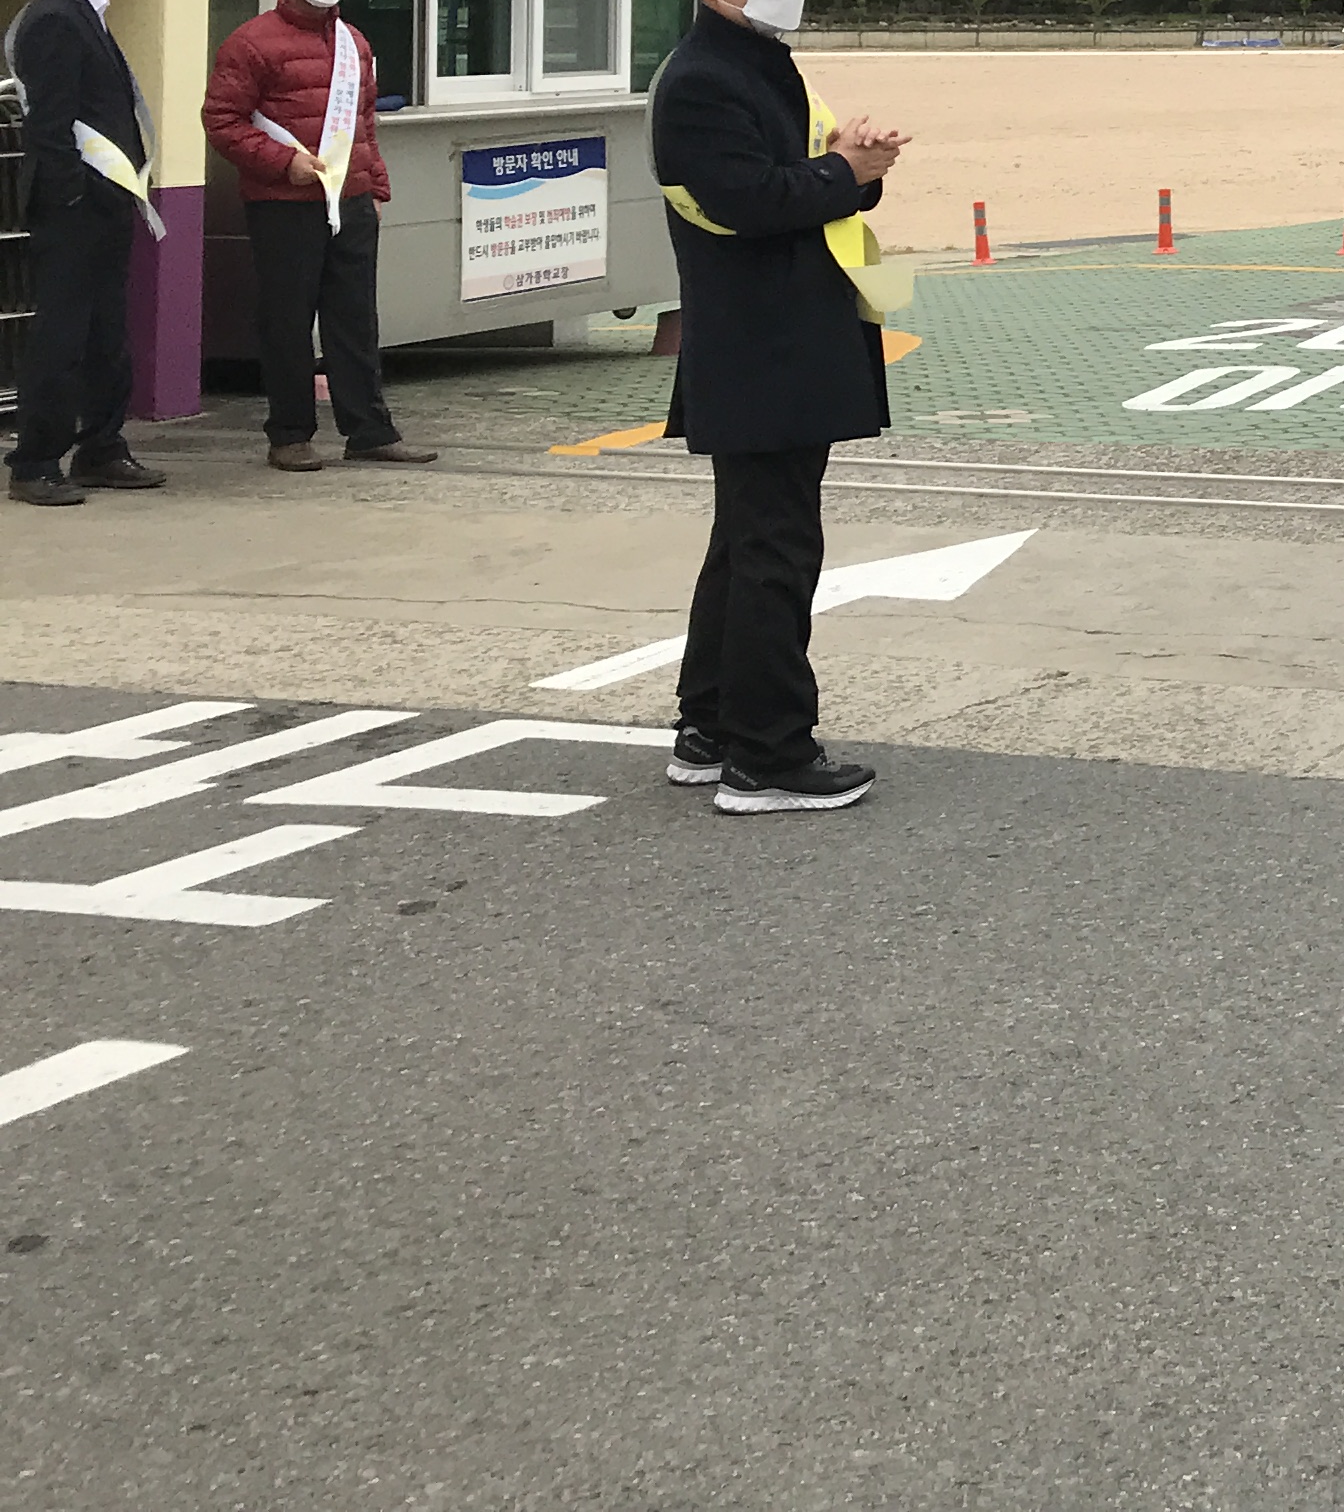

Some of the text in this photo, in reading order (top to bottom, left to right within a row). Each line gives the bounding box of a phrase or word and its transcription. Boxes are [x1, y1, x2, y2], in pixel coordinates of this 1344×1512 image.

[493, 148, 579, 176] 방문자 확인 안내
[516, 266, 569, 288] 삼가중학교장
